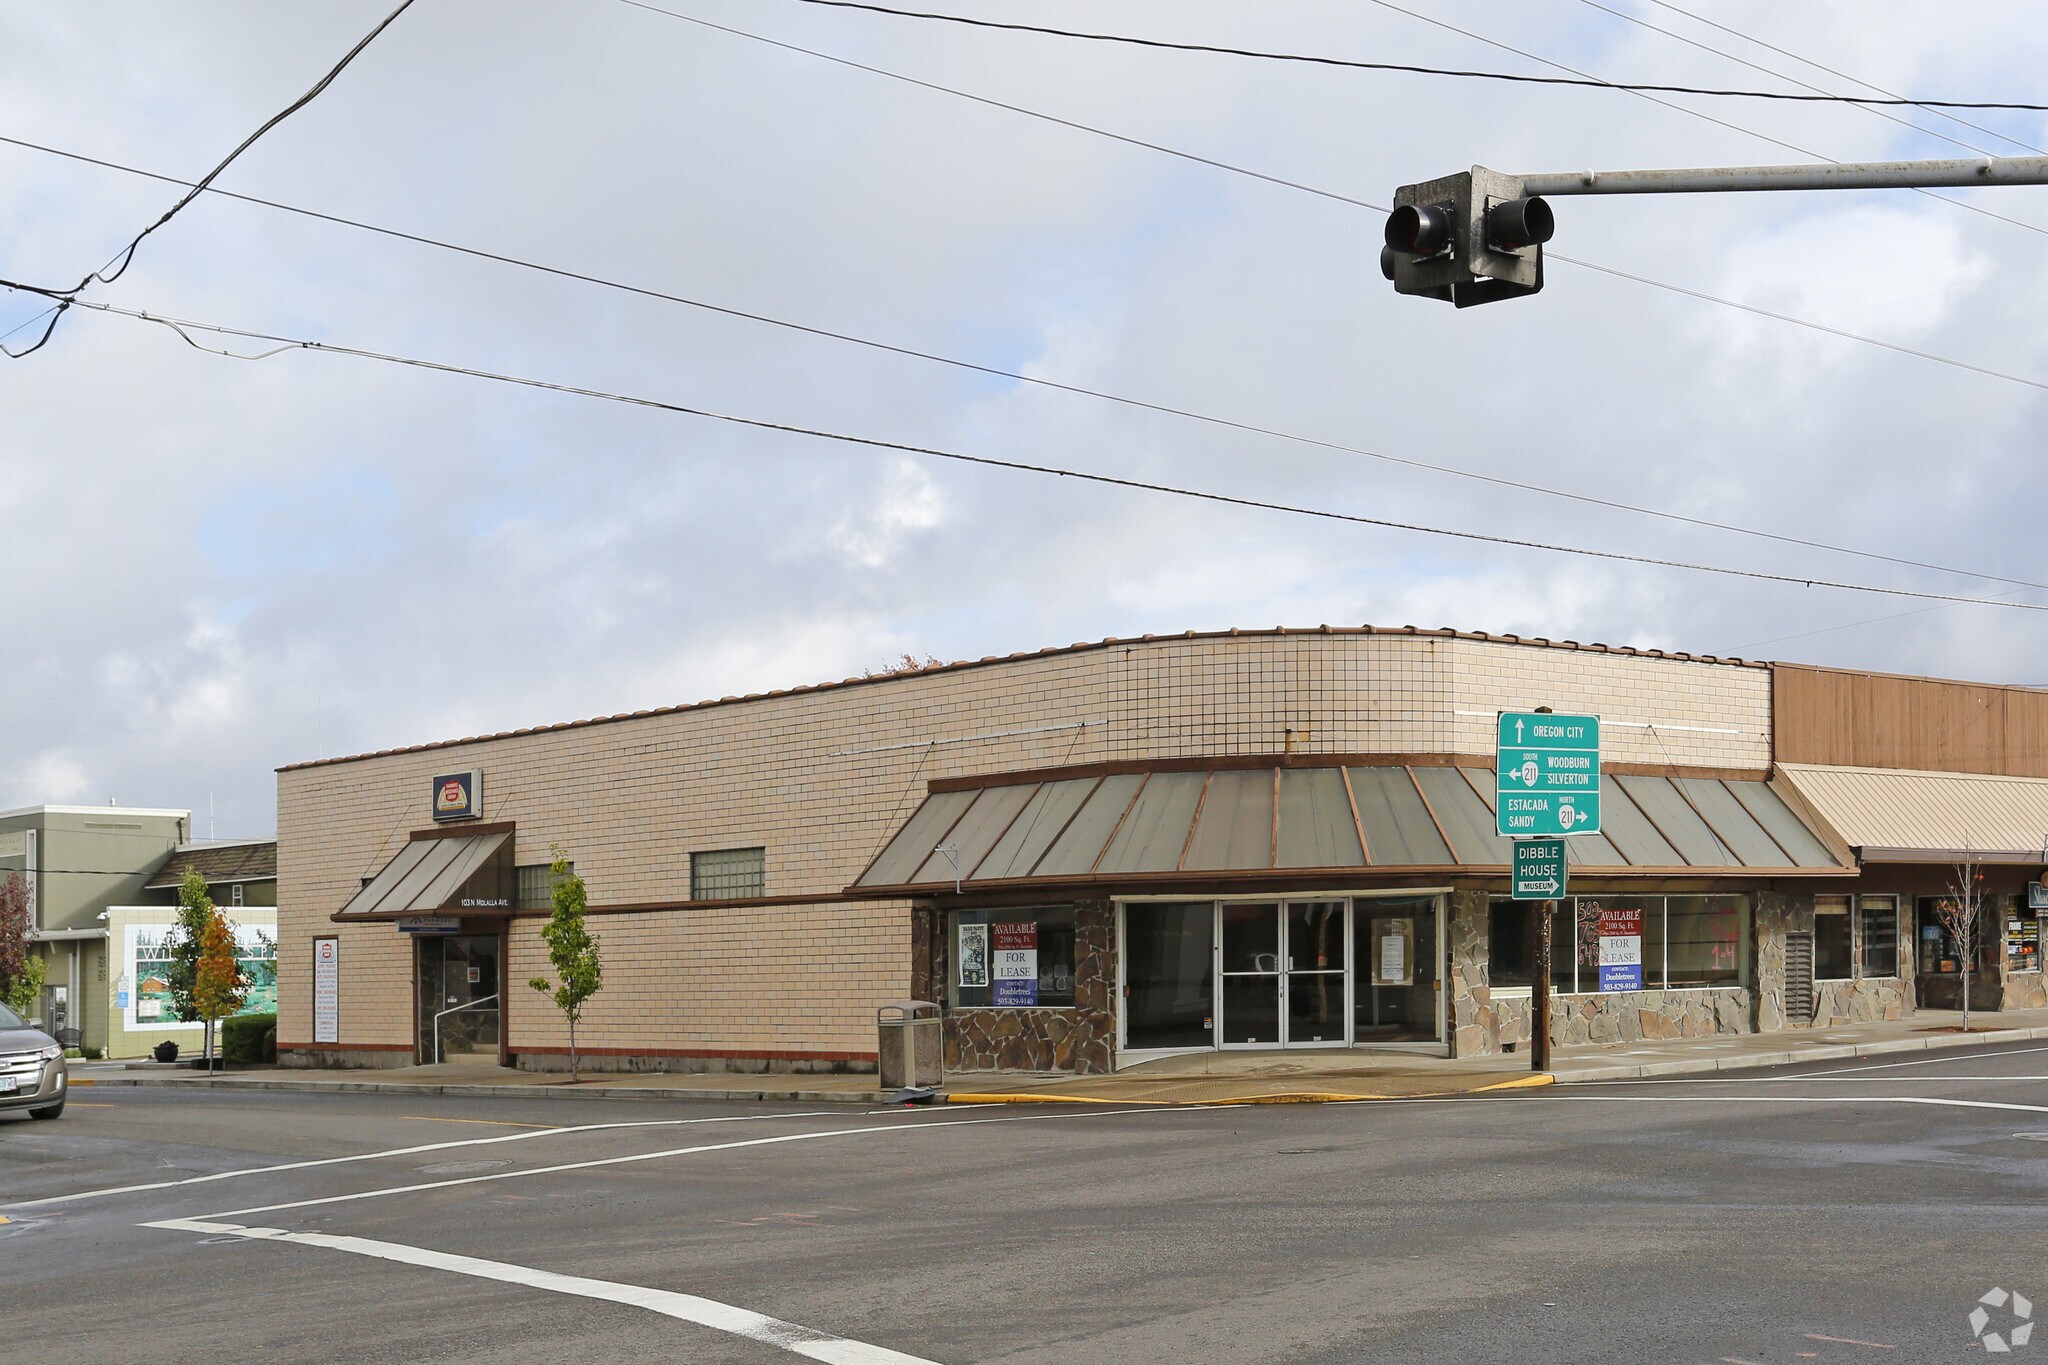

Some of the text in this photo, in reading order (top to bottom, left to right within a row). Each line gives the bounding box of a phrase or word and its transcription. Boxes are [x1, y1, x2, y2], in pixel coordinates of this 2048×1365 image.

[1533, 725, 1585, 738] OREGON CITY
[1522, 753, 1538, 761] SOUTH
[1547, 756, 1590, 769] WOODBURN
[1524, 767, 1537, 781] 211
[1547, 773, 1589, 785] SILVERTON
[1508, 799, 1549, 811] ESTACADA
[1558, 796, 1575, 804] NORTH
[1508, 815, 1535, 828] SANDY
[1561, 810, 1573, 824] 211
[1519, 847, 1559, 859] DIBBLE
[1520, 864, 1558, 877] HOUSE
[1523, 881, 1554, 890] MUSEUM
[1600, 911, 1640, 921] AVAILABLE
[994, 924, 1036, 934] AVAILABLE
[1605, 922, 1618, 930] 2100
[1000, 935, 1013, 943] 2100
[1610, 939, 1629, 948] FOR
[1006, 952, 1026, 962] FOR
[1605, 953, 1635, 962] LEASE
[1000, 967, 1031, 977] LEASE
[1603, 982, 1638, 991] 503-829-9140
